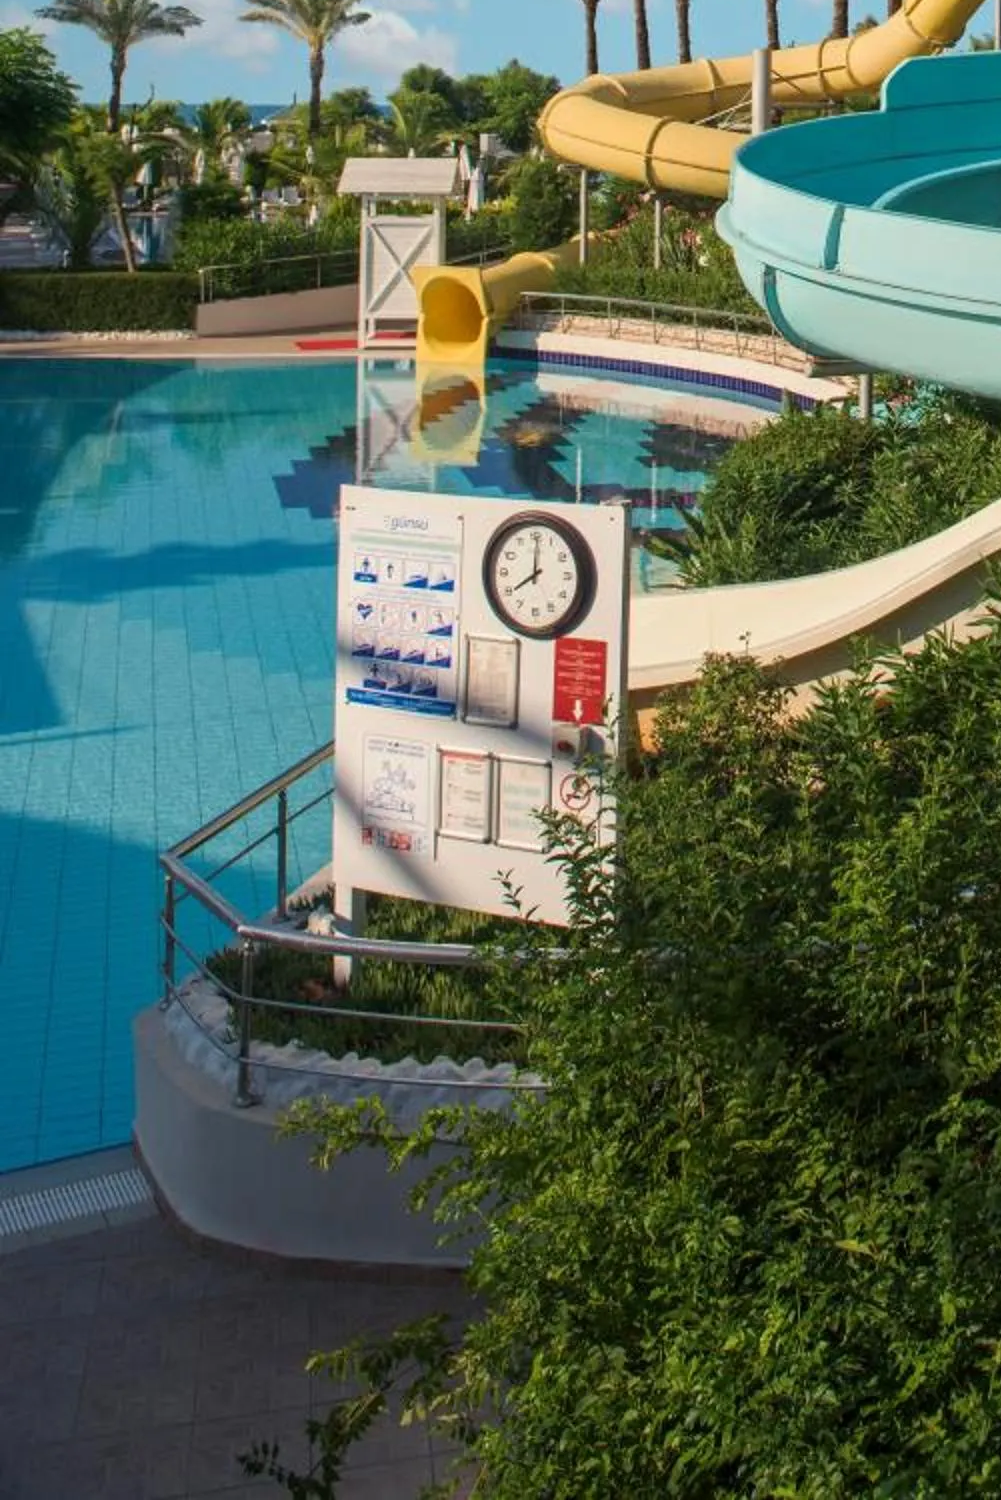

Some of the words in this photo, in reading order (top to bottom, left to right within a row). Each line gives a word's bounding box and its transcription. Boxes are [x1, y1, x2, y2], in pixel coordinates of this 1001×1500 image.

[559, 552, 567, 562] 2
[500, 567, 508, 577] 9
[563, 572, 572, 581] 3
[505, 586, 512, 596] 8
[559, 590, 566, 598] 4
[516, 599, 524, 609] 7
[547, 603, 555, 612] 5
[531, 607, 540, 617] 6
